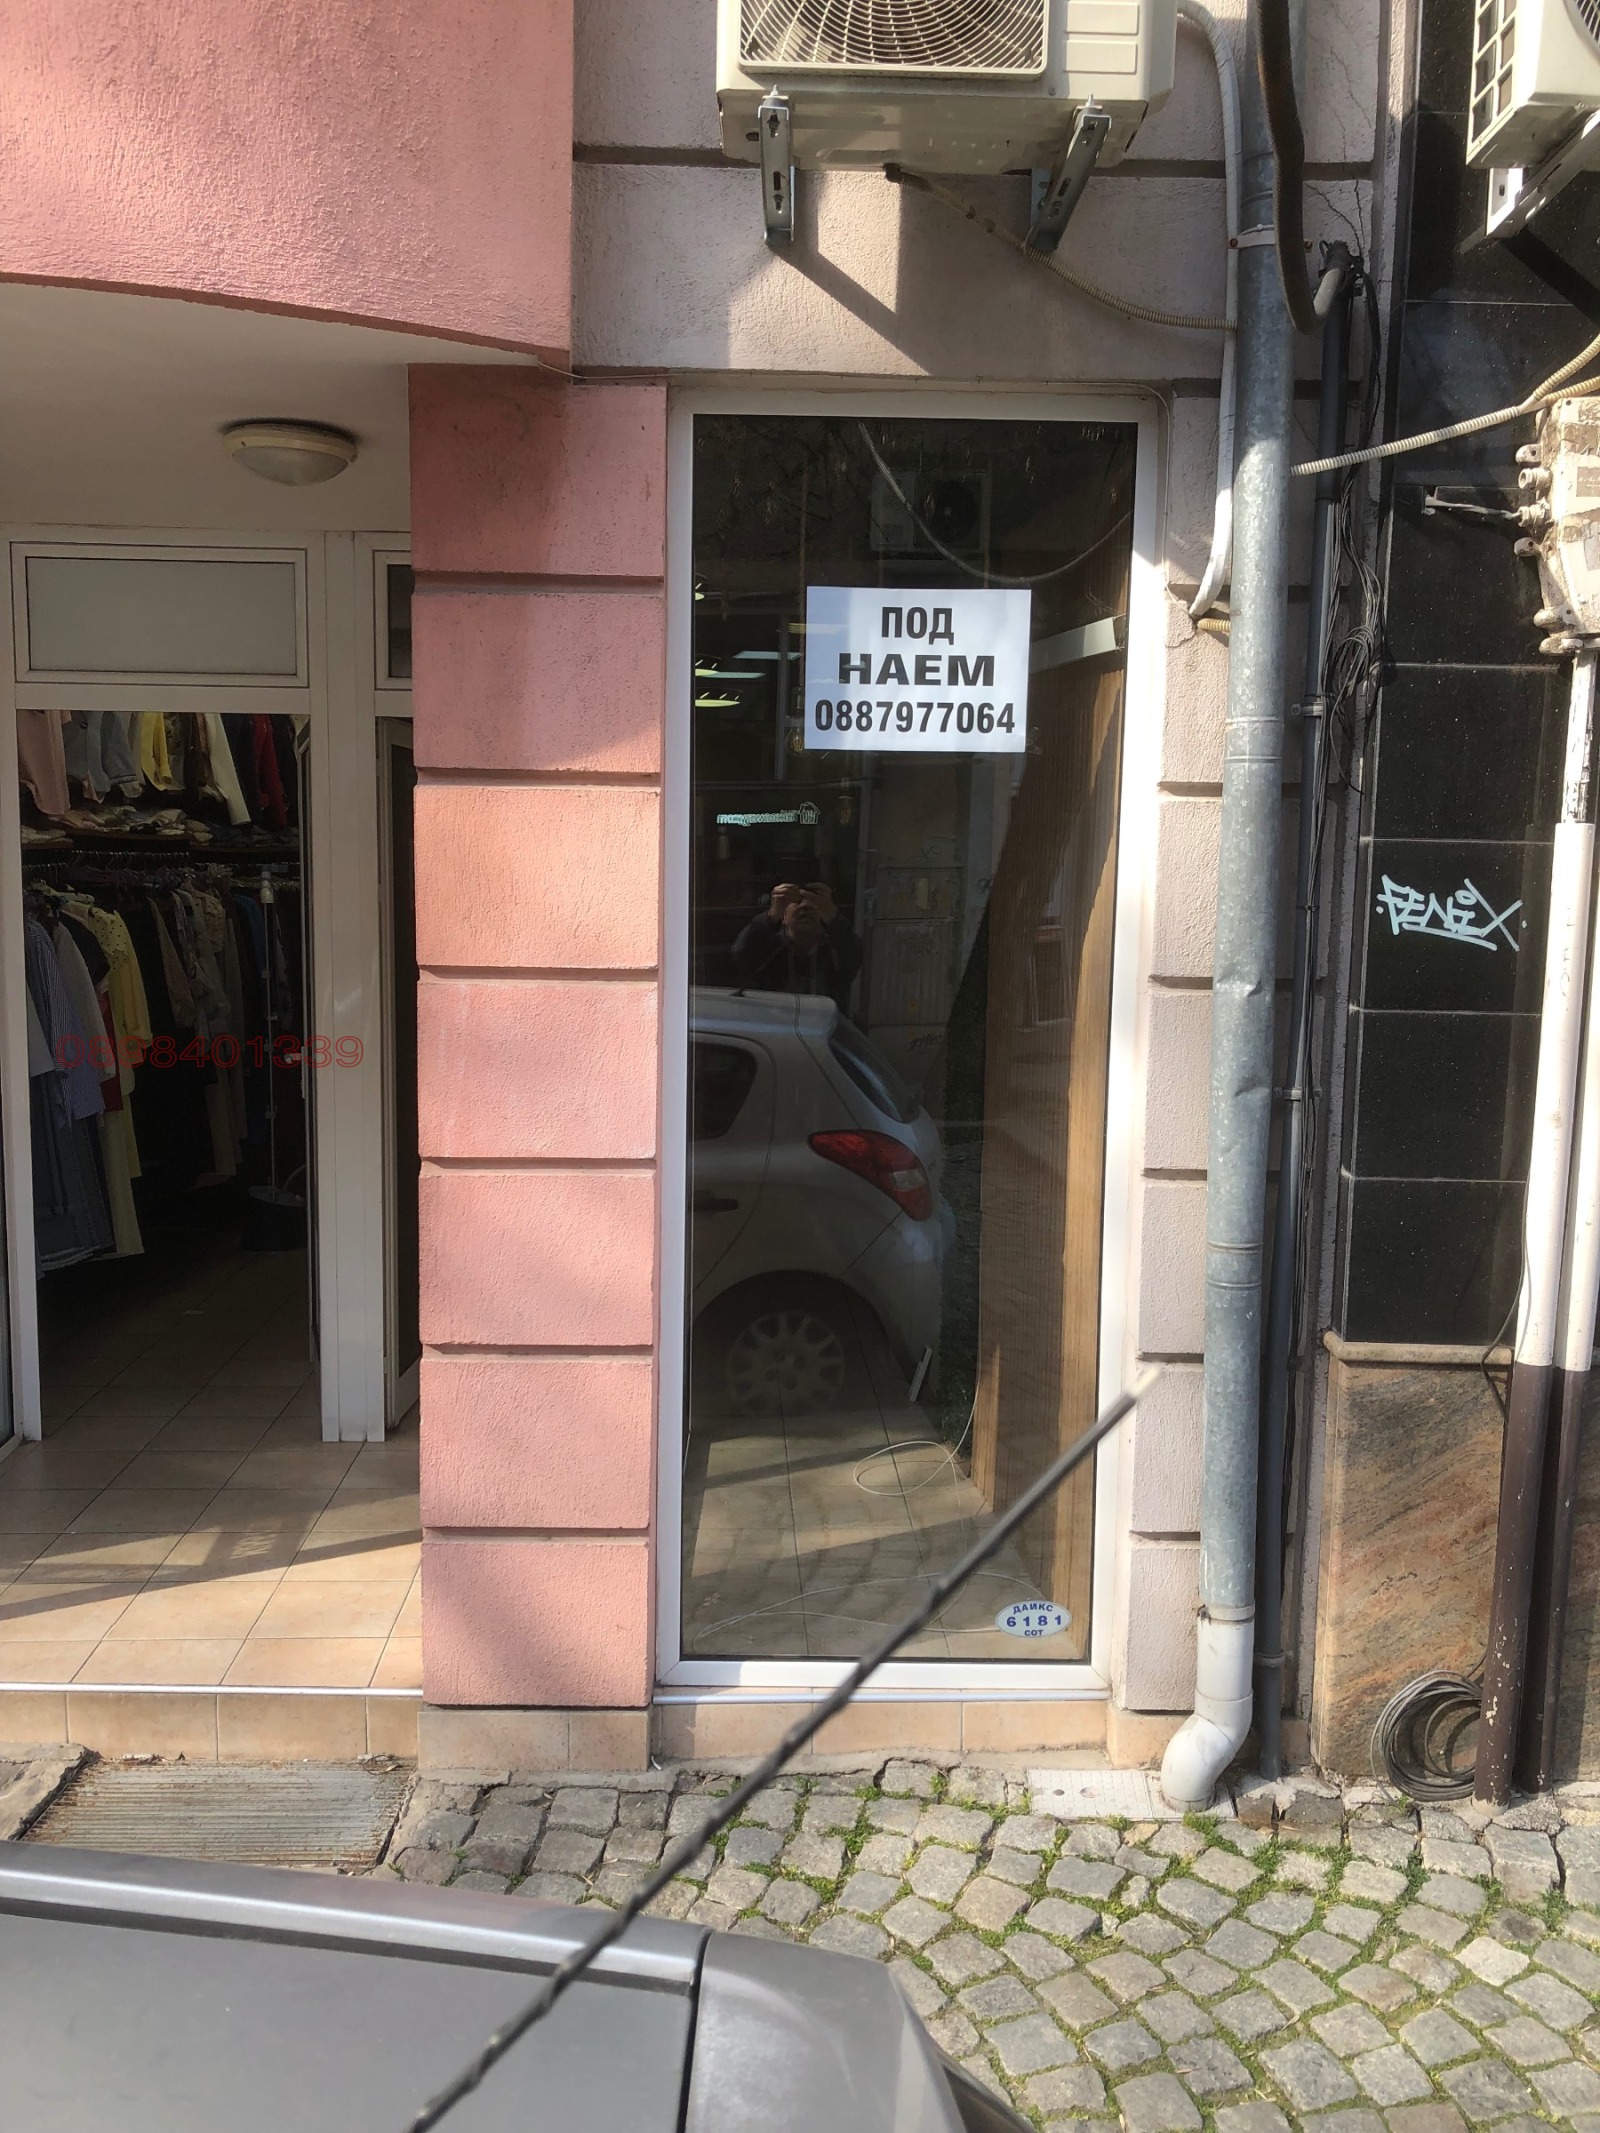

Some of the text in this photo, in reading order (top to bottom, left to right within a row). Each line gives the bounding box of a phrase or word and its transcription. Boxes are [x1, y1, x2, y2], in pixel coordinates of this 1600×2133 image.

[881, 606, 954, 645] ПОД
[838, 652, 995, 687] НАЕМ
[815, 699, 1015, 734] 0887977064
[1006, 1615, 1062, 1628] 6181
[1024, 1629, 1044, 1637] СОТ
